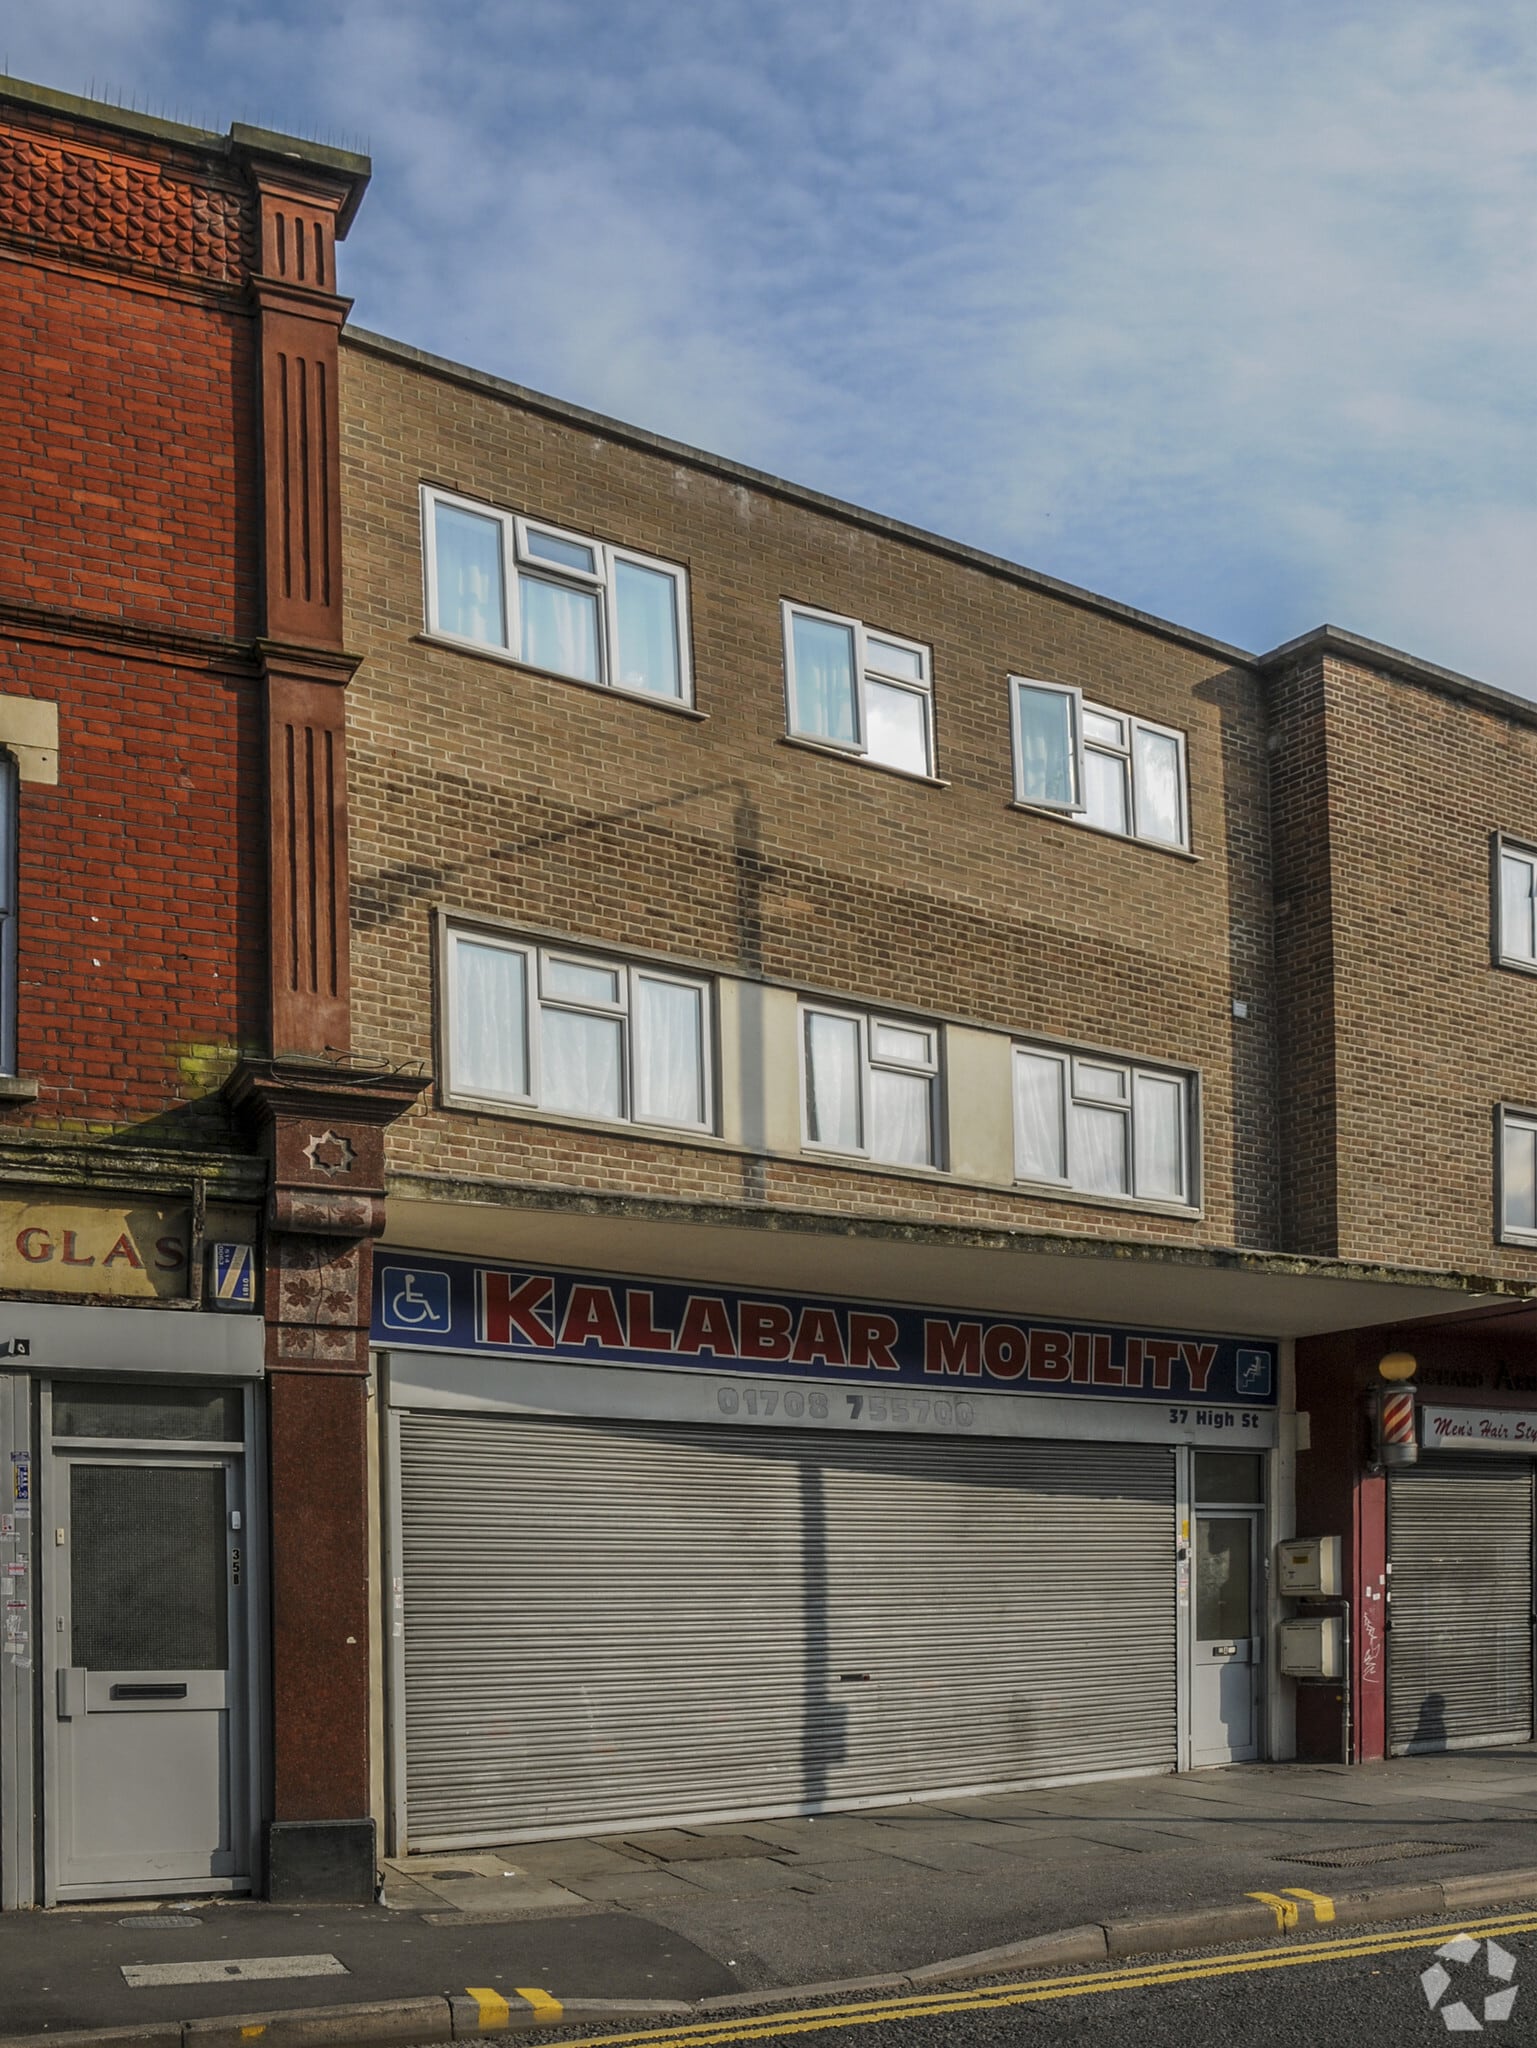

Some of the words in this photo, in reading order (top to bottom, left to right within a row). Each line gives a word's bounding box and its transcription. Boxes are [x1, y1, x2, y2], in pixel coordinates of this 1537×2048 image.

[16, 1227, 187, 1272] GLAS
[475, 1269, 900, 1371] KALABAR
[923, 1318, 1218, 1392] MOBILITY
[717, 1387, 829, 1418] 01708
[846, 1395, 975, 1427] 755700
[1169, 1409, 1188, 1424] 37
[1196, 1410, 1234, 1429] High
[1242, 1413, 1259, 1428] St
[1433, 1416, 1473, 1437] Men's
[1479, 1419, 1509, 1439] Hair
